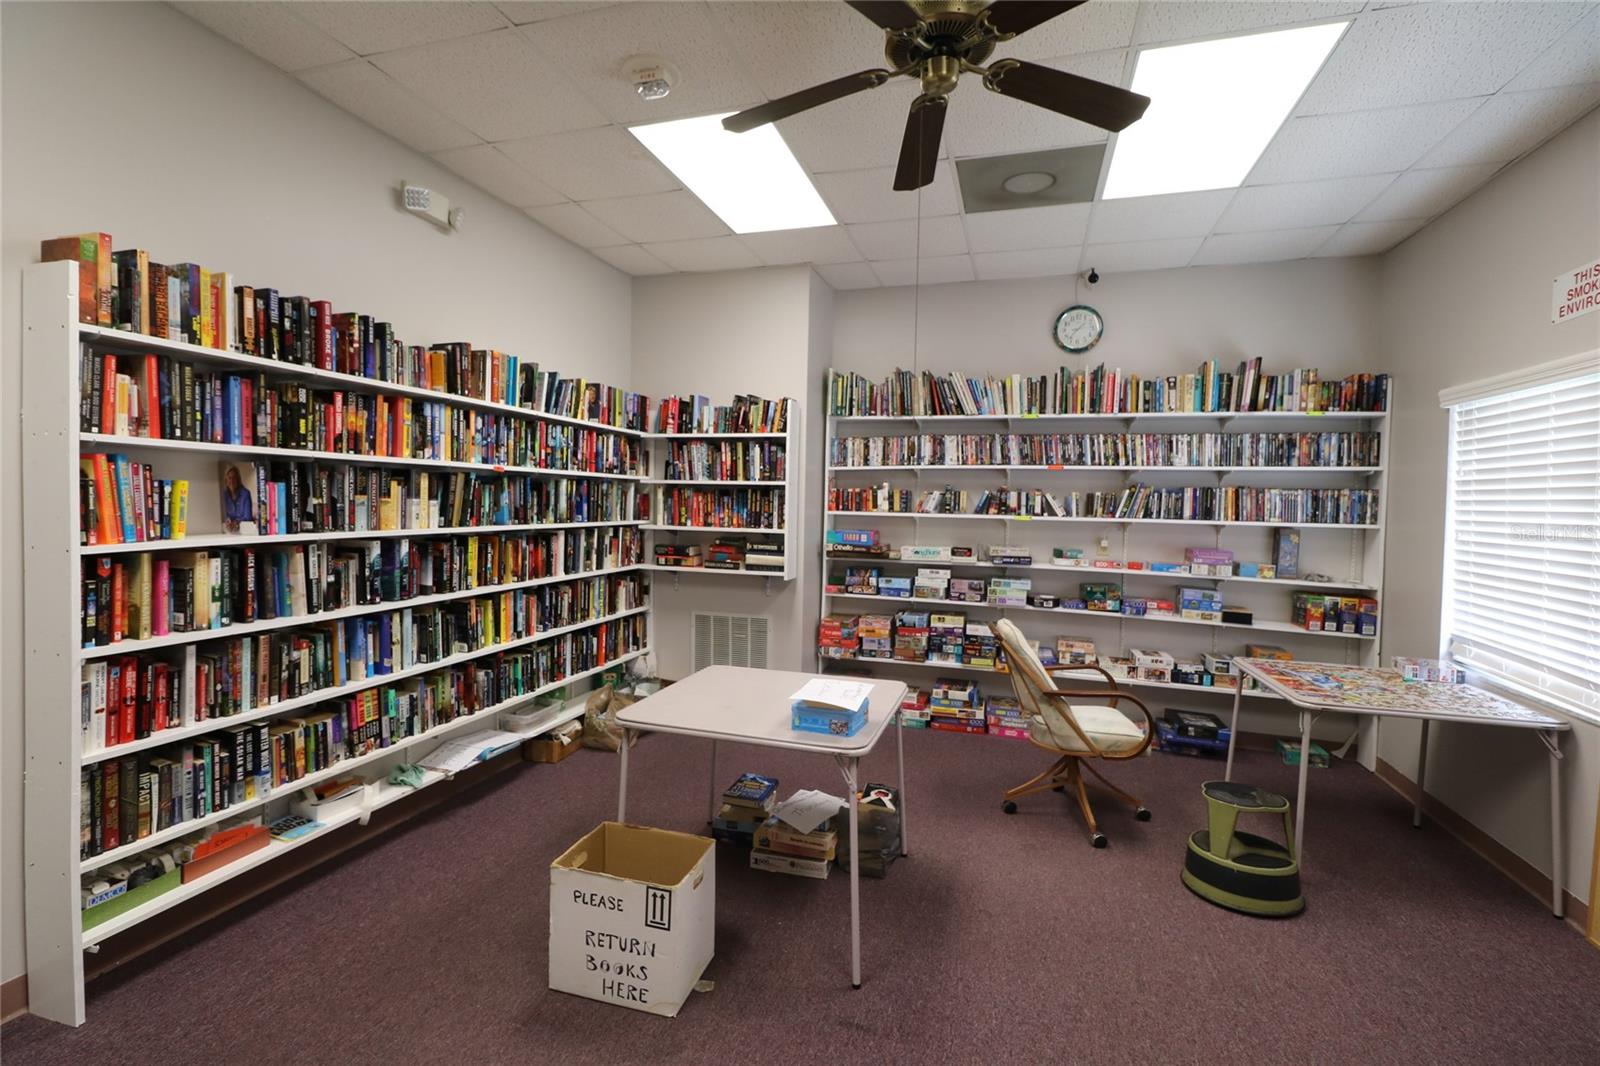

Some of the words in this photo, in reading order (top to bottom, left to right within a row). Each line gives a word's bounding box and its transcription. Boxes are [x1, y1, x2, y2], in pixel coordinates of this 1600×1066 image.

[1573, 264, 1600, 285] THIS
[1567, 279, 1600, 301] SMOK
[833, 543, 854, 552] Othello
[260, 727, 269, 751] WINTER
[236, 745, 245, 766] SOLAR
[236, 766, 245, 782] WAR
[139, 772, 150, 806] IMPACT
[573, 890, 624, 912] PLEASE
[585, 930, 656, 957] RETURN
[586, 954, 649, 981] BOOKS
[602, 978, 650, 1003] HERE
